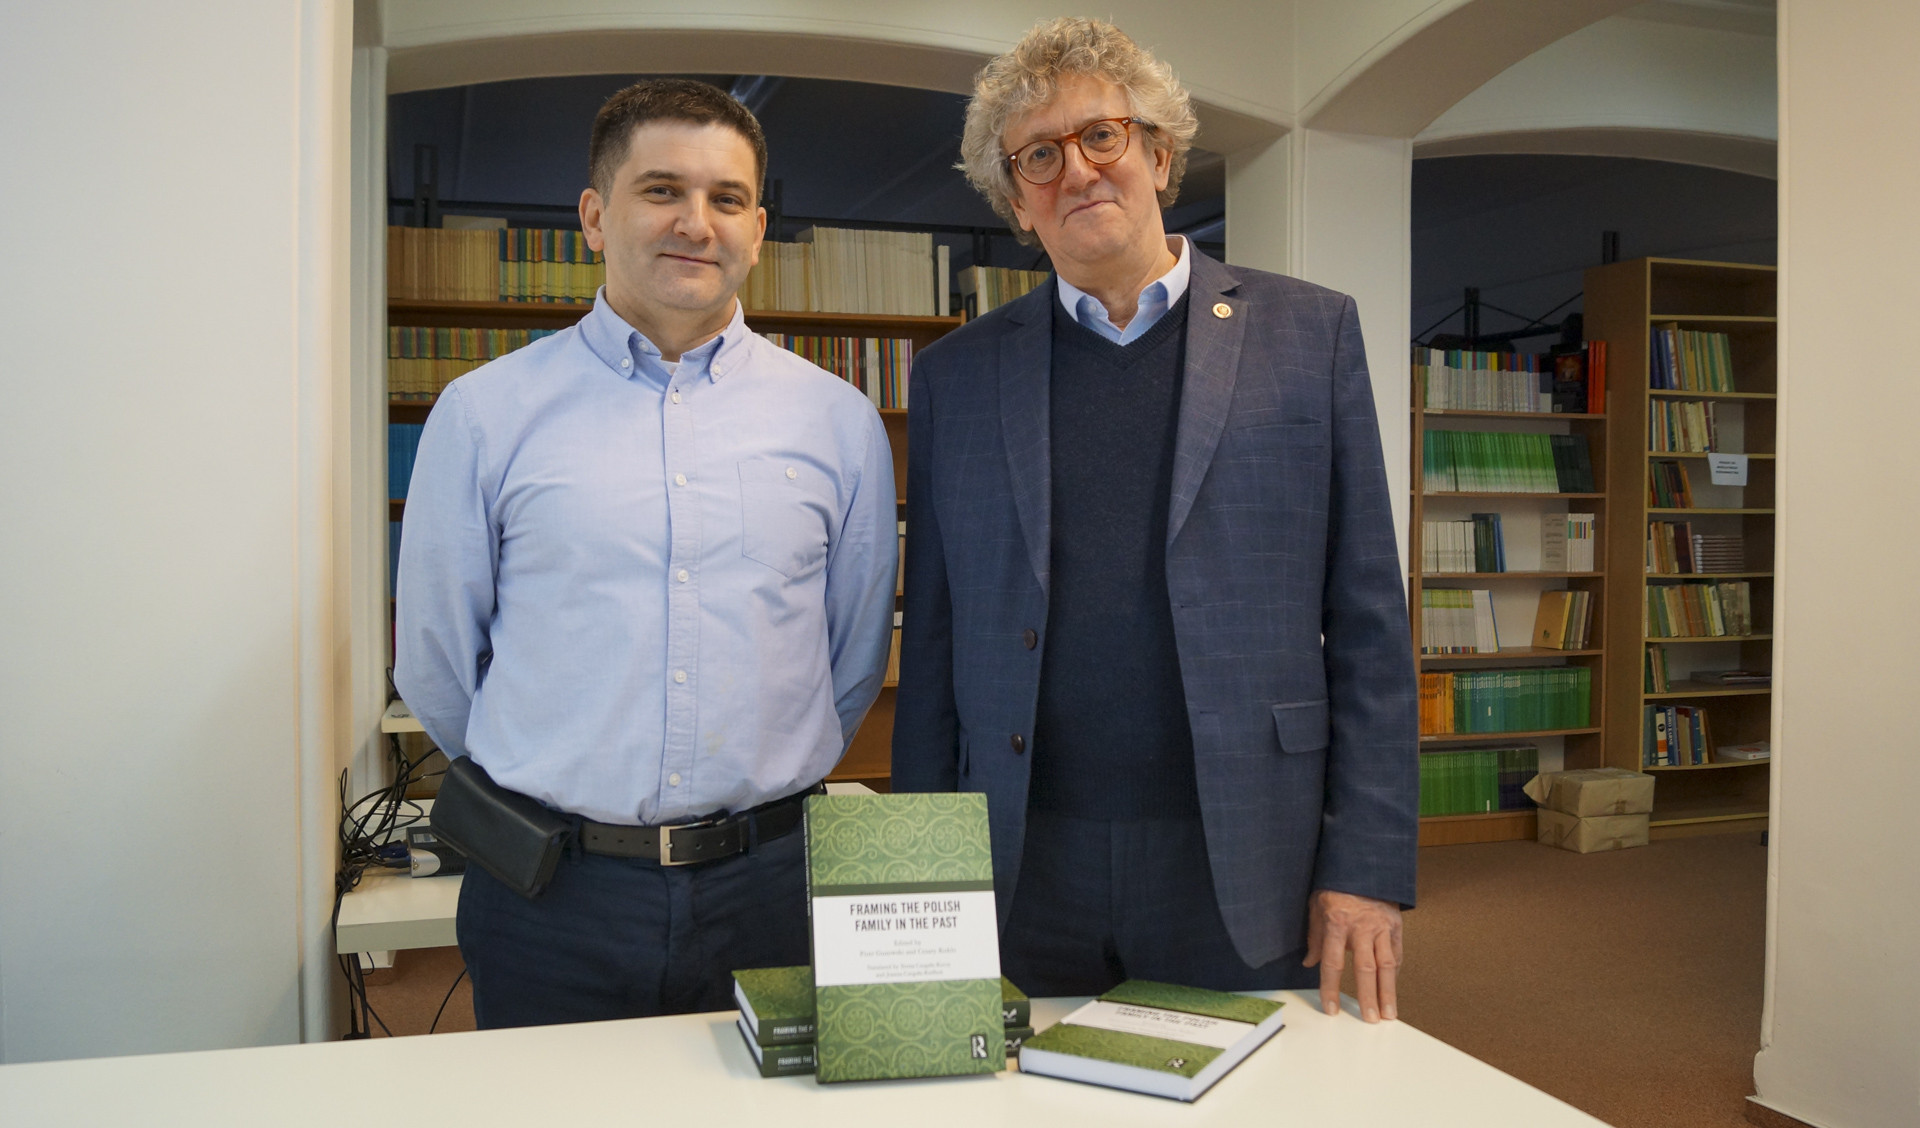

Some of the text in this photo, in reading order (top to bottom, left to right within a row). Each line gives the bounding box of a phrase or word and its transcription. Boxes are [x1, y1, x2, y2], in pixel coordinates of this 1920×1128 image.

[850, 900, 961, 916] FRAMING THE POLISH
[855, 916, 958, 932] FAMILY IN THE PAST
[971, 1035, 987, 1058] R
